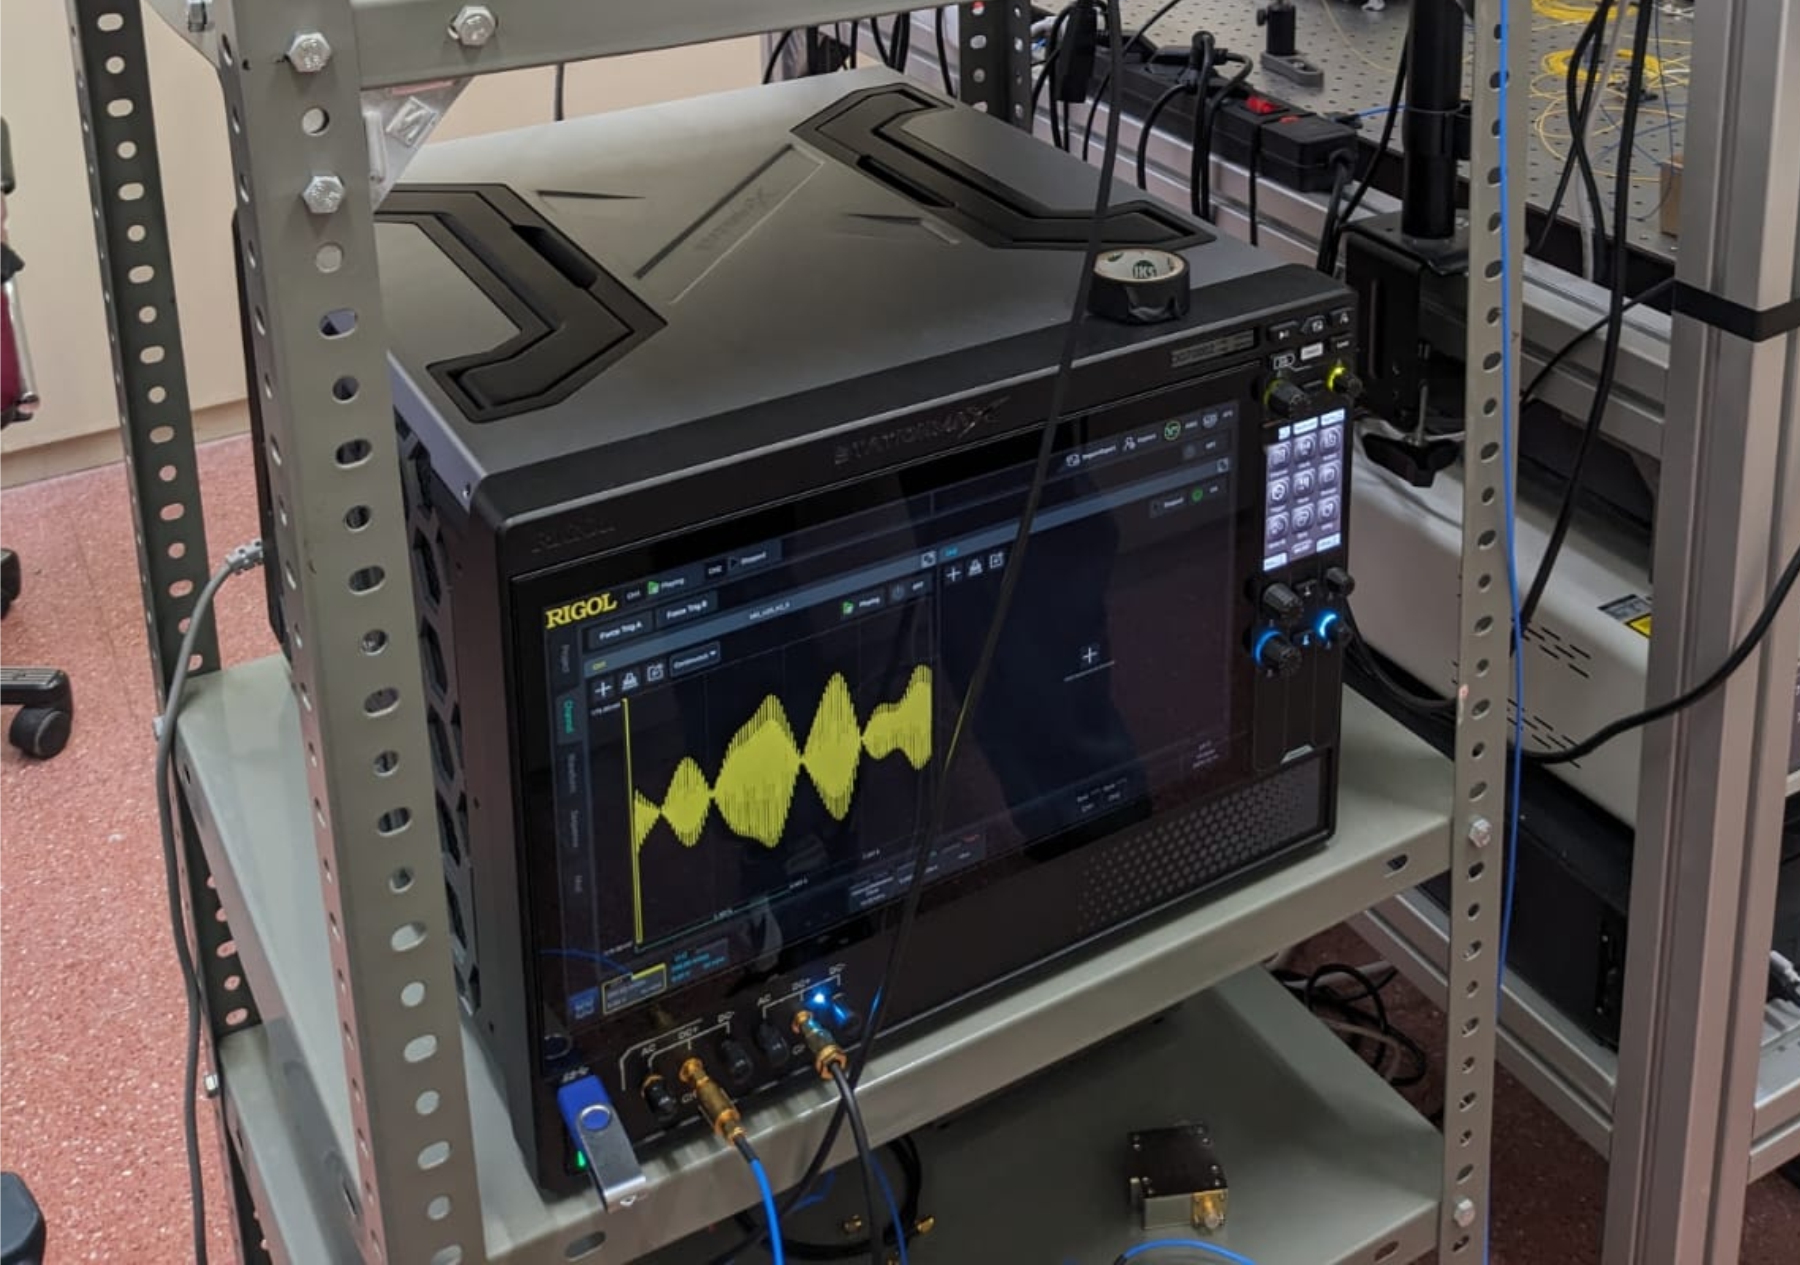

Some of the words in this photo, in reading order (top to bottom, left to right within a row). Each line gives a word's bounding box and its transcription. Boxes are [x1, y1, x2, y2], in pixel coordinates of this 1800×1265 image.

[545, 592, 618, 629] RIGOL
[666, 607, 687, 620] Force
[687, 602, 702, 615] Trig
[599, 628, 622, 641] Force
[621, 624, 636, 636] Trig
